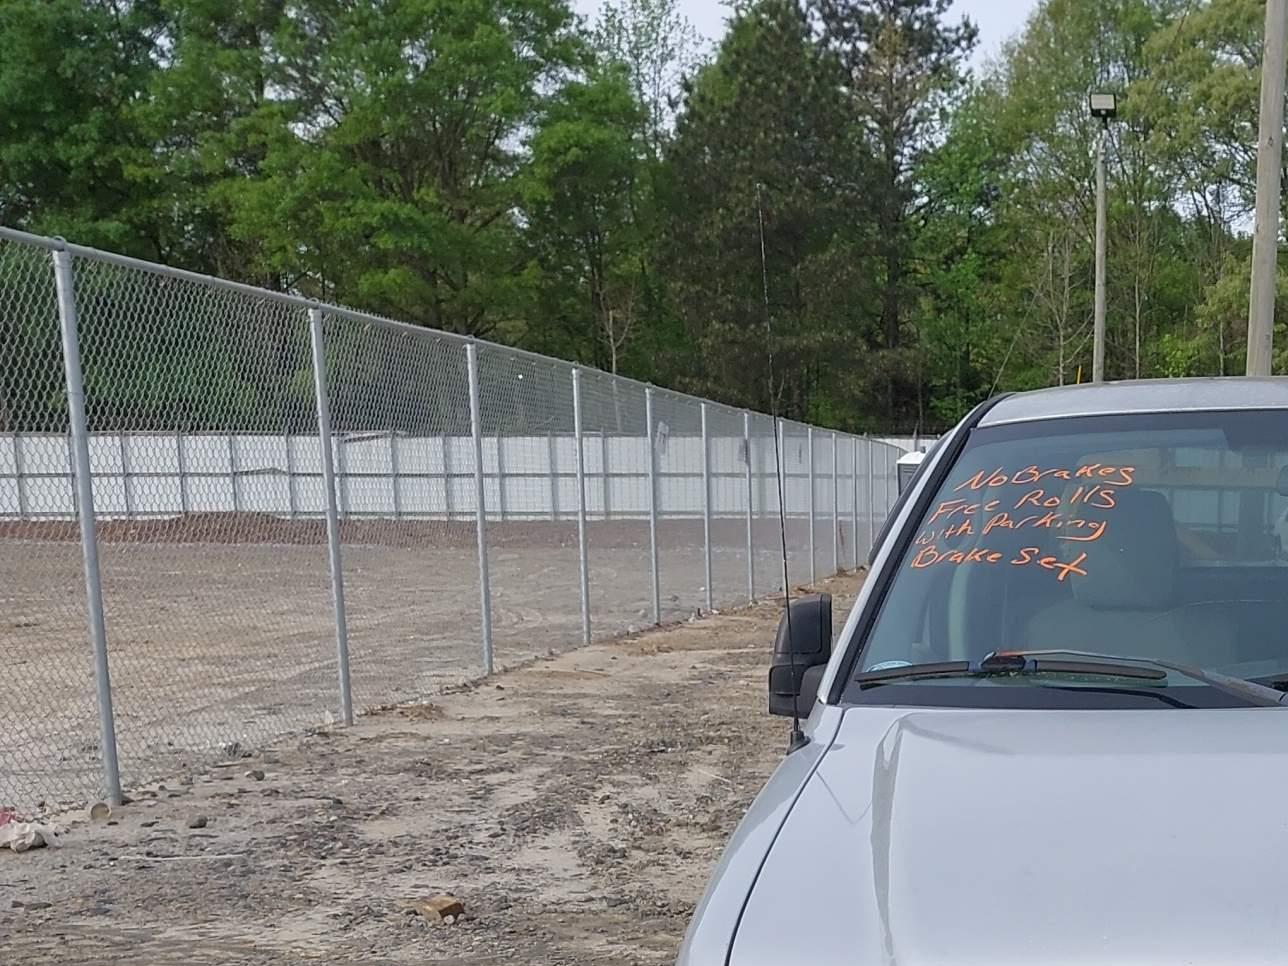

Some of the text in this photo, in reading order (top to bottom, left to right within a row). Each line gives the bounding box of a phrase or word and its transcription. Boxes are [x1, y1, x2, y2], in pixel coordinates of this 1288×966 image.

[927, 484, 1116, 525] Free Rolls
[915, 519, 976, 545] with
[910, 545, 1088, 581] Brake Set
